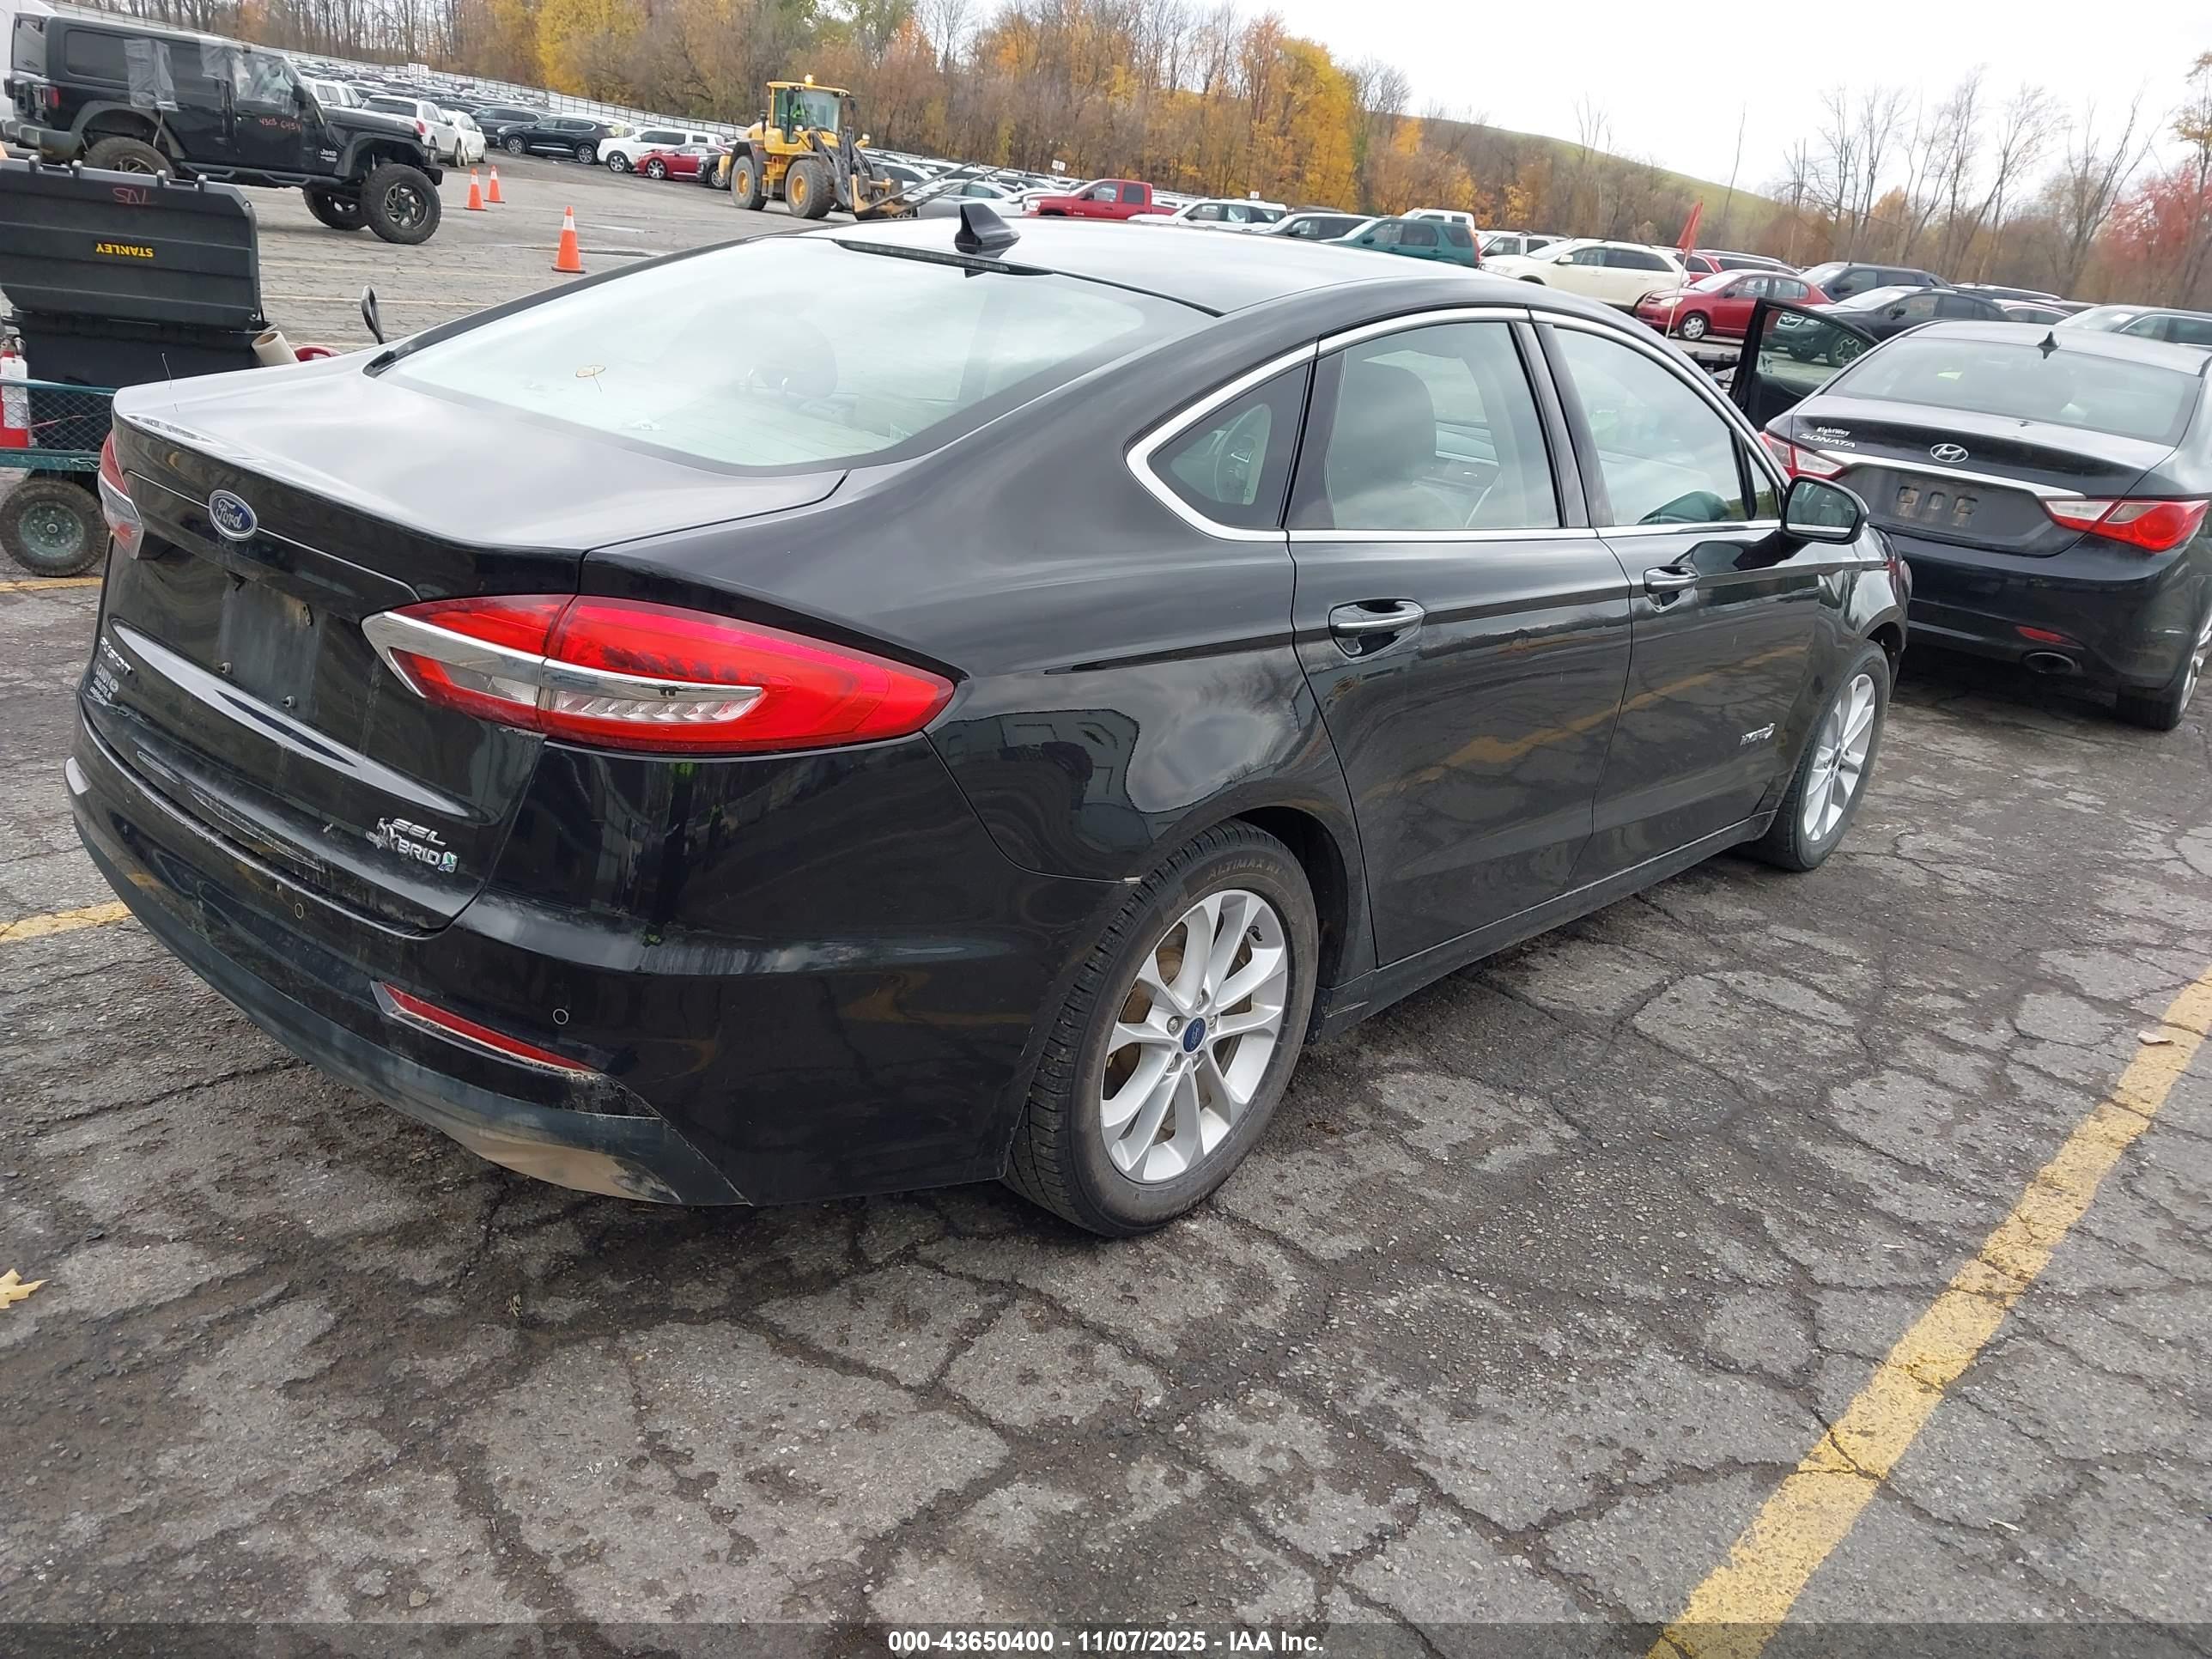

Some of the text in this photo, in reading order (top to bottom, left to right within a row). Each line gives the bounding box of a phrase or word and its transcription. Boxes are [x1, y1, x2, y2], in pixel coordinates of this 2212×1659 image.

[95, 243, 154, 258] STANLEY
[1799, 433, 1856, 448] SONATA
[216, 498, 243, 530] Ford
[391, 817, 447, 847] SEL
